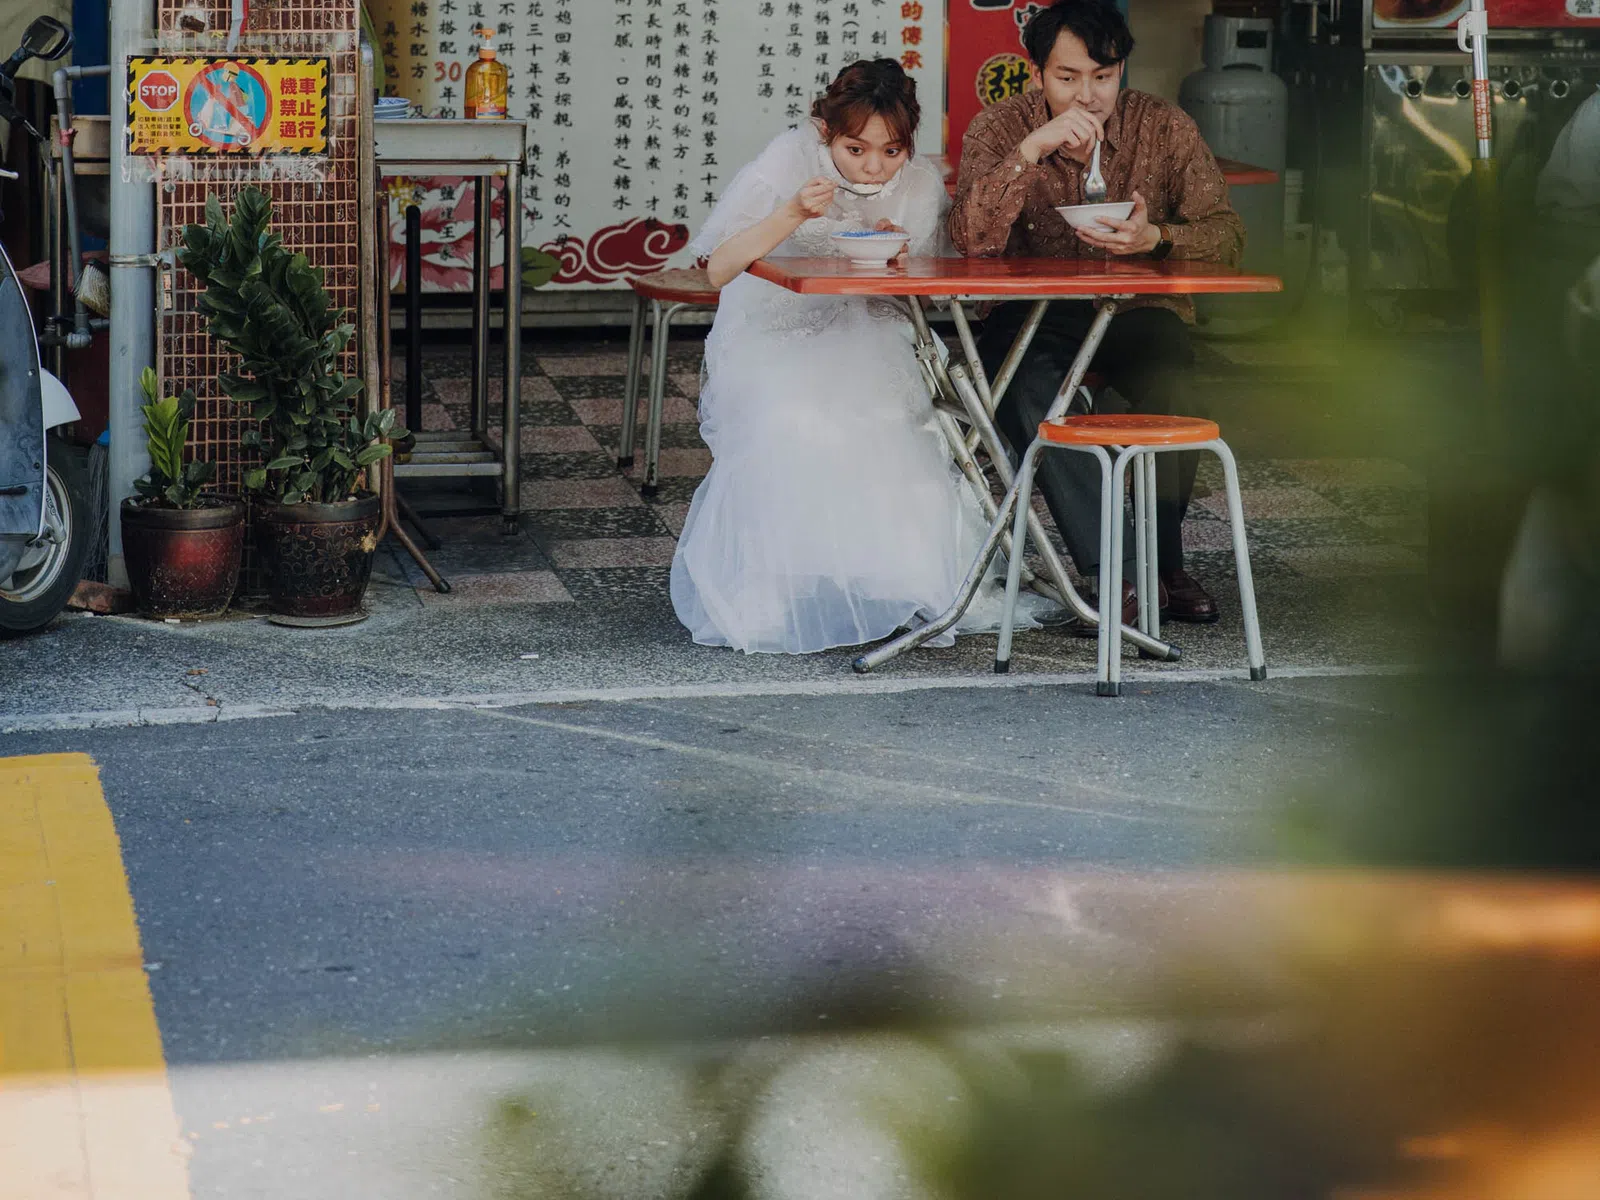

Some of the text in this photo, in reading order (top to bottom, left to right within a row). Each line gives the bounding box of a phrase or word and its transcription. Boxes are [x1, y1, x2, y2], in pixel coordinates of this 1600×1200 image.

[141, 85, 177, 97] STOP
[280, 77, 317, 96] 機車
[280, 99, 316, 117] 禁止
[280, 120, 316, 139] 通行
